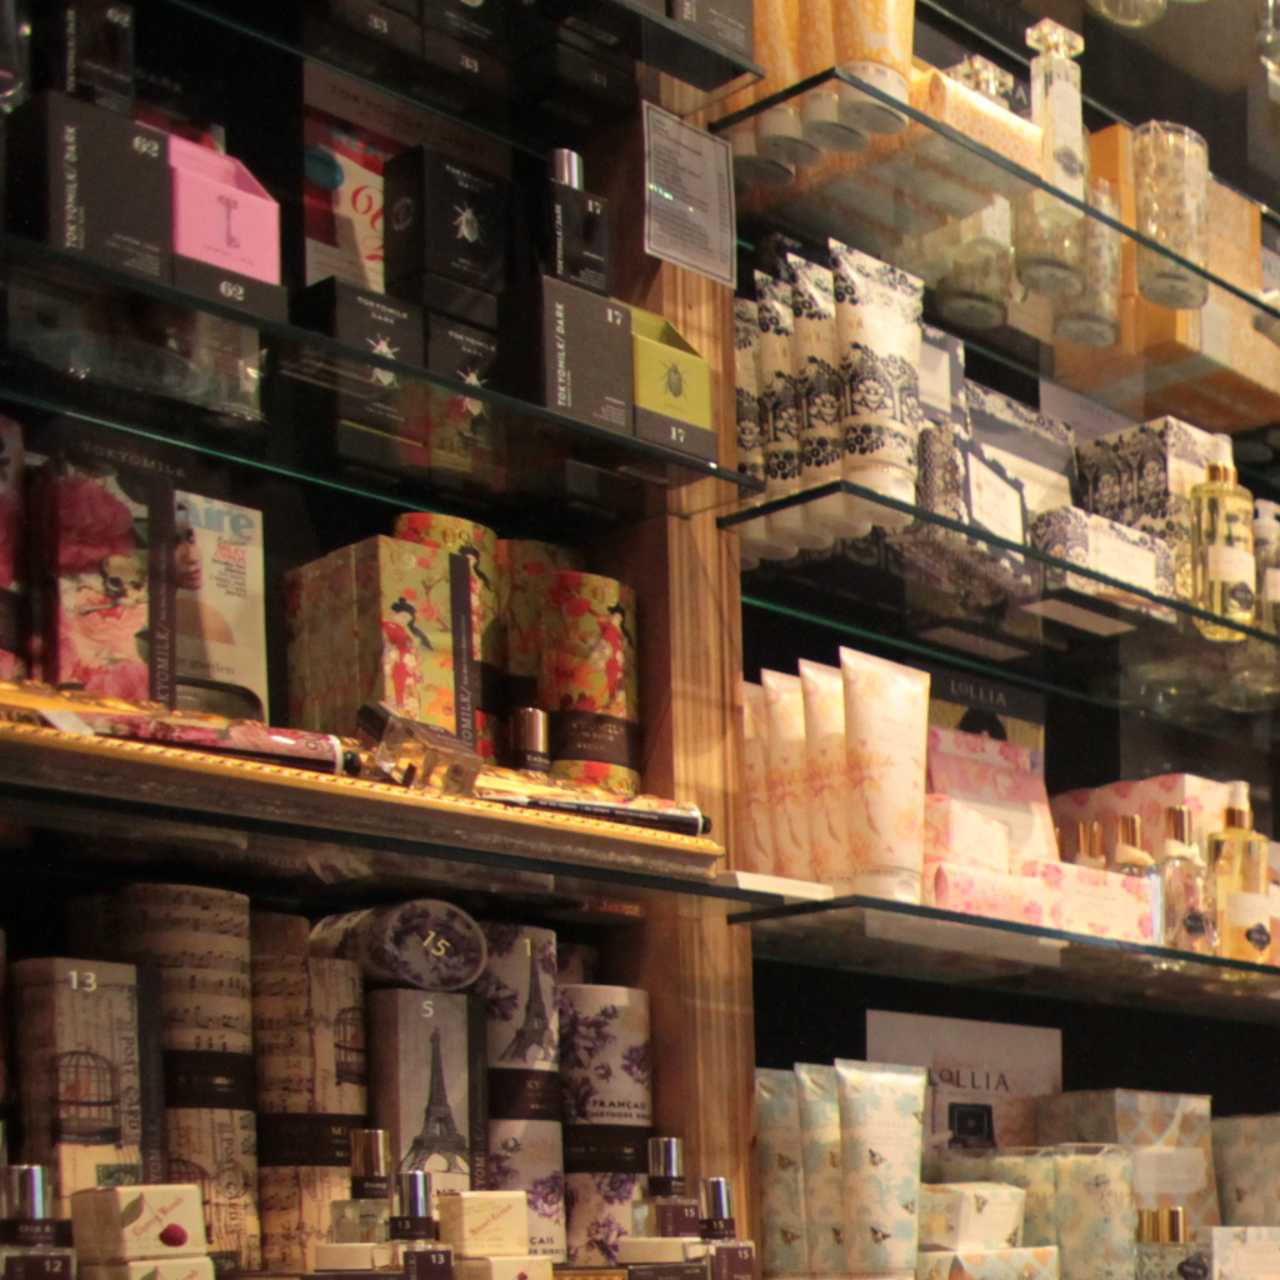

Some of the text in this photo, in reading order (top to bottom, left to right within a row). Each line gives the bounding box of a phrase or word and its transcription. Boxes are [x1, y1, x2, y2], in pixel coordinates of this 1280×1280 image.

[64, 124, 78, 161] DARK
[132, 135, 160, 158] 62
[587, 199, 602, 215] 17
[218, 280, 246, 301] 62
[555, 301, 565, 334] DARK
[606, 307, 624, 326] 17
[670, 426, 686, 443] 17
[950, 678, 1008, 706] LOLLIA
[422, 930, 452, 957] 15
[70, 970, 98, 993] 13
[422, 1001, 435, 1018] 5
[928, 1068, 1010, 1093] LOLLIA
[683, 1207, 696, 1218] 15
[430, 1253, 445, 1265] 13
[737, 1249, 750, 1260] 15
[43, 1260, 63, 1273] 12
